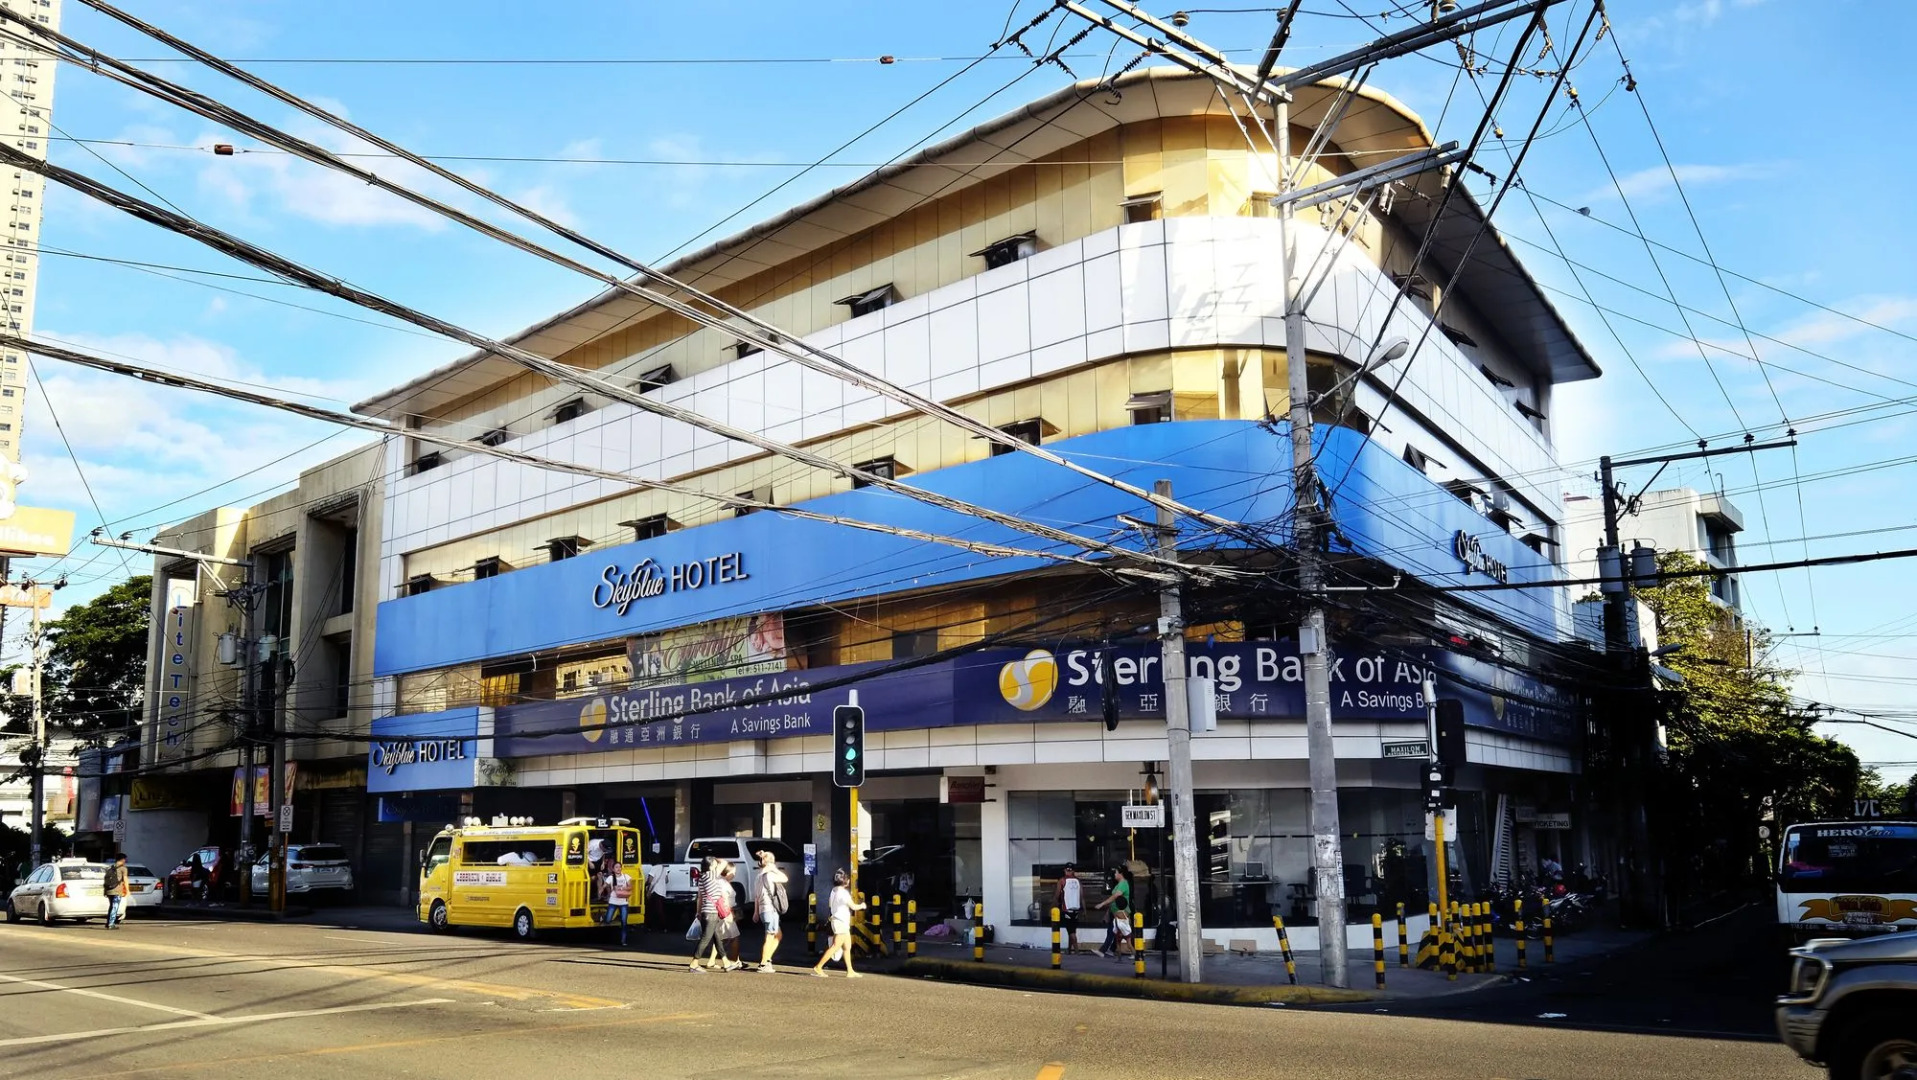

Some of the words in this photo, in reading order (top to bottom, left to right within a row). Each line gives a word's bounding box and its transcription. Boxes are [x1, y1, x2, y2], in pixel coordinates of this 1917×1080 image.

[592, 562, 665, 616] Skyblue
[671, 552, 749, 593] HOTEL
[1256, 648, 1346, 683] Bak
[610, 689, 684, 724] Sterling
[691, 684, 737, 713] Bank
[743, 678, 763, 710] of
[768, 676, 811, 707] Asia
[1341, 691, 1353, 708] A
[1358, 690, 1413, 712] Savings
[731, 719, 739, 734] A
[742, 715, 781, 735] Savings
[784, 712, 811, 729] Bank
[372, 741, 415, 775] Skyblue
[419, 740, 465, 762] HOTEL
[1854, 799, 1880, 817] 17C
[1817, 828, 1863, 838] HERO
